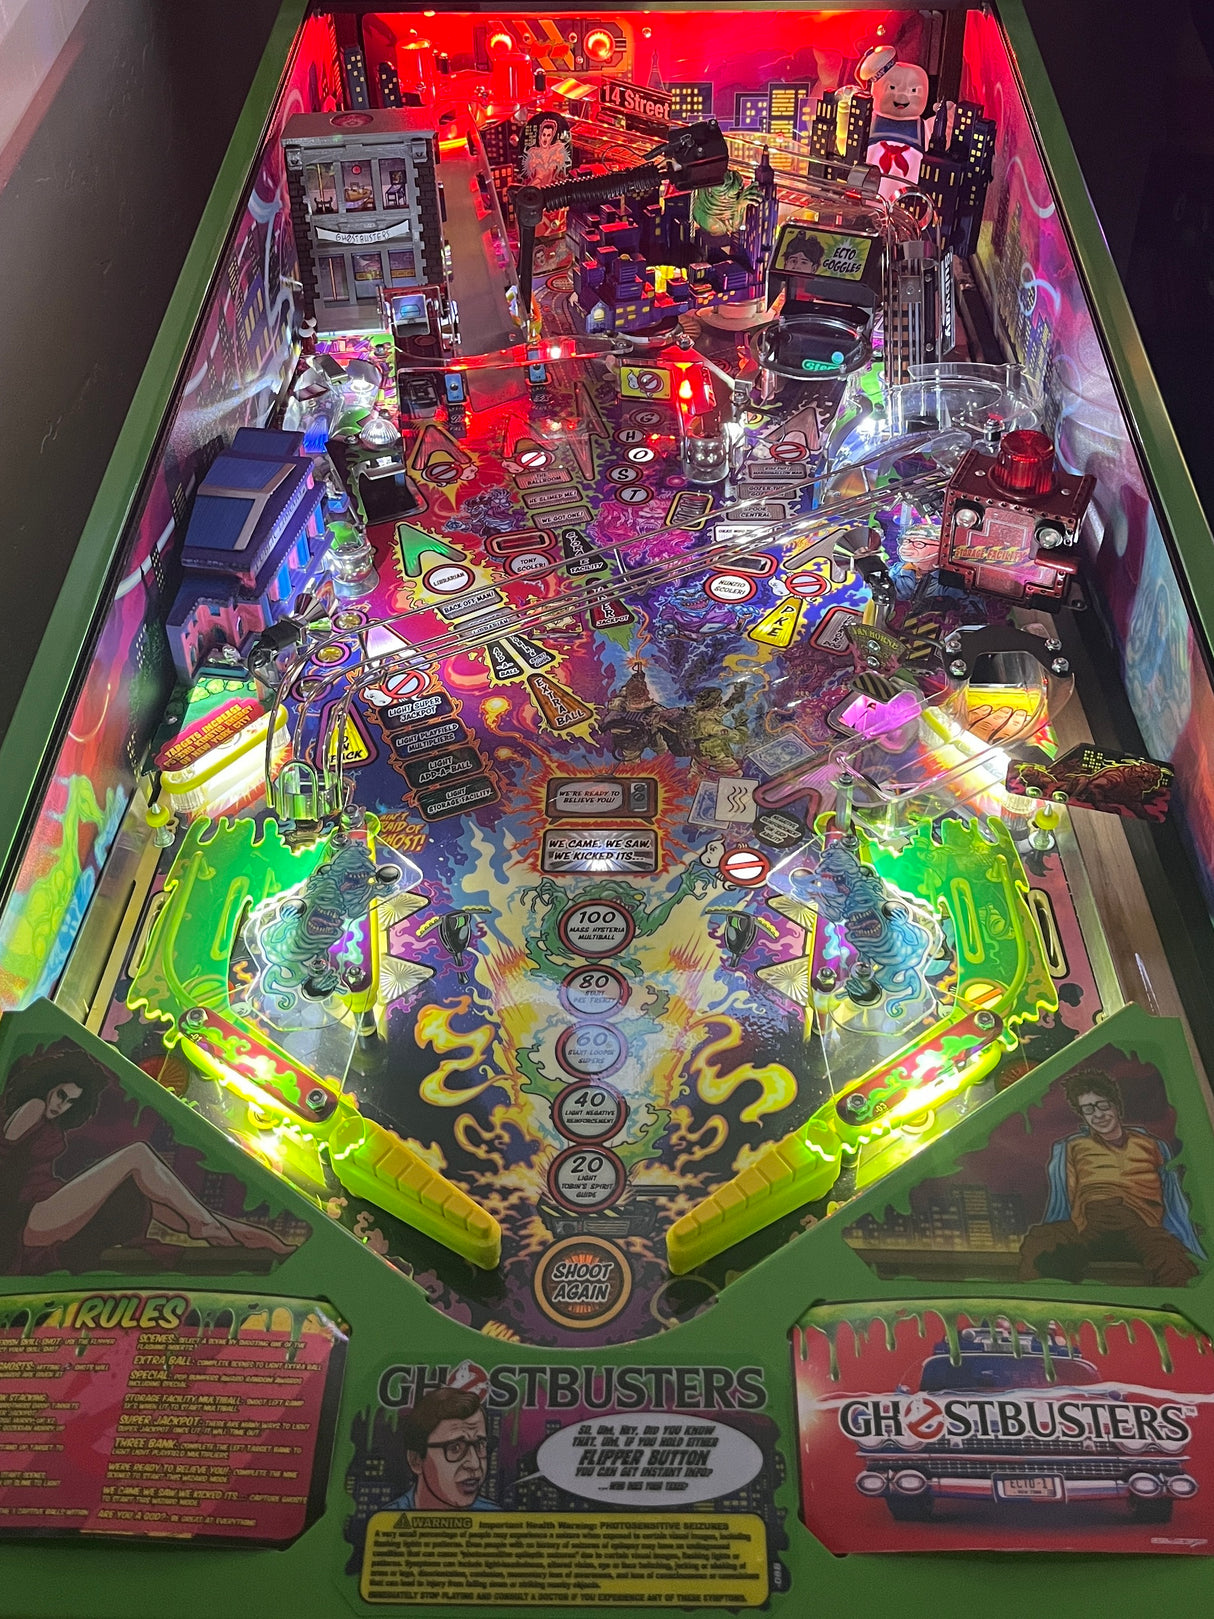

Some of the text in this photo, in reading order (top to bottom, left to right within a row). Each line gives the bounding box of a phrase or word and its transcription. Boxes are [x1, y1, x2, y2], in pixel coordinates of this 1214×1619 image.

[603, 84, 670, 120] 14 Street
[832, 247, 857, 260] ECTO
[822, 259, 862, 273] GOGGLES
[527, 476, 562, 486] BALLROOM
[540, 494, 563, 502] SLIMED
[567, 511, 584, 519] ONE!
[517, 562, 546, 573] SCOLERI
[520, 557, 537, 565] TONY
[570, 562, 604, 574] FACILITY
[718, 579, 746, 588] NUNZIO
[714, 586, 745, 595] SCOLERI
[443, 591, 495, 615] BACK OFF MAN!
[595, 615, 629, 627] JACKPOT
[851, 626, 899, 650] VAN HORNE
[498, 667, 521, 678] BALL
[534, 676, 567, 715] EXTRA
[387, 696, 442, 717] LIGHT SUPER
[400, 705, 437, 722] JACKPOT
[555, 709, 586, 727] BALL
[164, 703, 242, 758] TARGETS INCREASE
[194, 705, 254, 747] KINETIC ENERGY
[179, 714, 251, 766] OF NEW YORK CITY
[395, 723, 459, 747] LIGHT PLAYFIELD
[407, 733, 456, 753] MULTIPLIERS
[428, 756, 453, 770] LIGHT
[450, 760, 473, 773] BALL
[445, 787, 467, 799] LIGHT
[426, 787, 492, 814] STORAGE FACILITY
[405, 823, 426, 834] OF
[548, 839, 652, 849] WE CAME, WE SAW,
[553, 851, 645, 861] WE KICKED ITS...
[578, 911, 616, 924] 100
[579, 974, 610, 989] 80
[576, 1031, 608, 1047] 60
[574, 1091, 606, 1108] 40
[570, 1155, 604, 1174] 20
[577, 1174, 598, 1182] LIGHT
[552, 1262, 614, 1281] SHOOT
[552, 1283, 610, 1302] AGAIN
[74, 1296, 188, 1329] RULES
[133, 1355, 167, 1365] EXTRA
[197, 1360, 229, 1368] COMPLETE
[264, 1361, 283, 1369] LIGHT
[124, 1393, 161, 1403] STORAGE
[162, 1394, 197, 1403] FACILITY
[118, 1414, 153, 1425] SUPER
[292, 1423, 311, 1431] LIGHT
[662, 1425, 682, 1436] YOU
[683, 1425, 717, 1436] KNOW
[114, 1437, 147, 1448] THREE
[623, 1437, 720, 1448] IF YOU HOLD EITHER
[577, 1448, 712, 1466] FLIPPER BUTTON
[132, 1463, 161, 1472] READY
[162, 1464, 174, 1473] TO
[175, 1464, 209, 1474] BELIEVE
[574, 1466, 714, 1478] YOU CAN GET INSTANT INFO?
[1010, 1477, 1049, 1490] ECTO-1
[103, 1485, 117, 1495] WE
[142, 1487, 157, 1496] WE
[178, 1489, 193, 1498] WE
[117, 1510, 136, 1519] YOU
[412, 1517, 472, 1529] WARNING
[600, 1521, 681, 1530] PHOTOSENSITIVE
